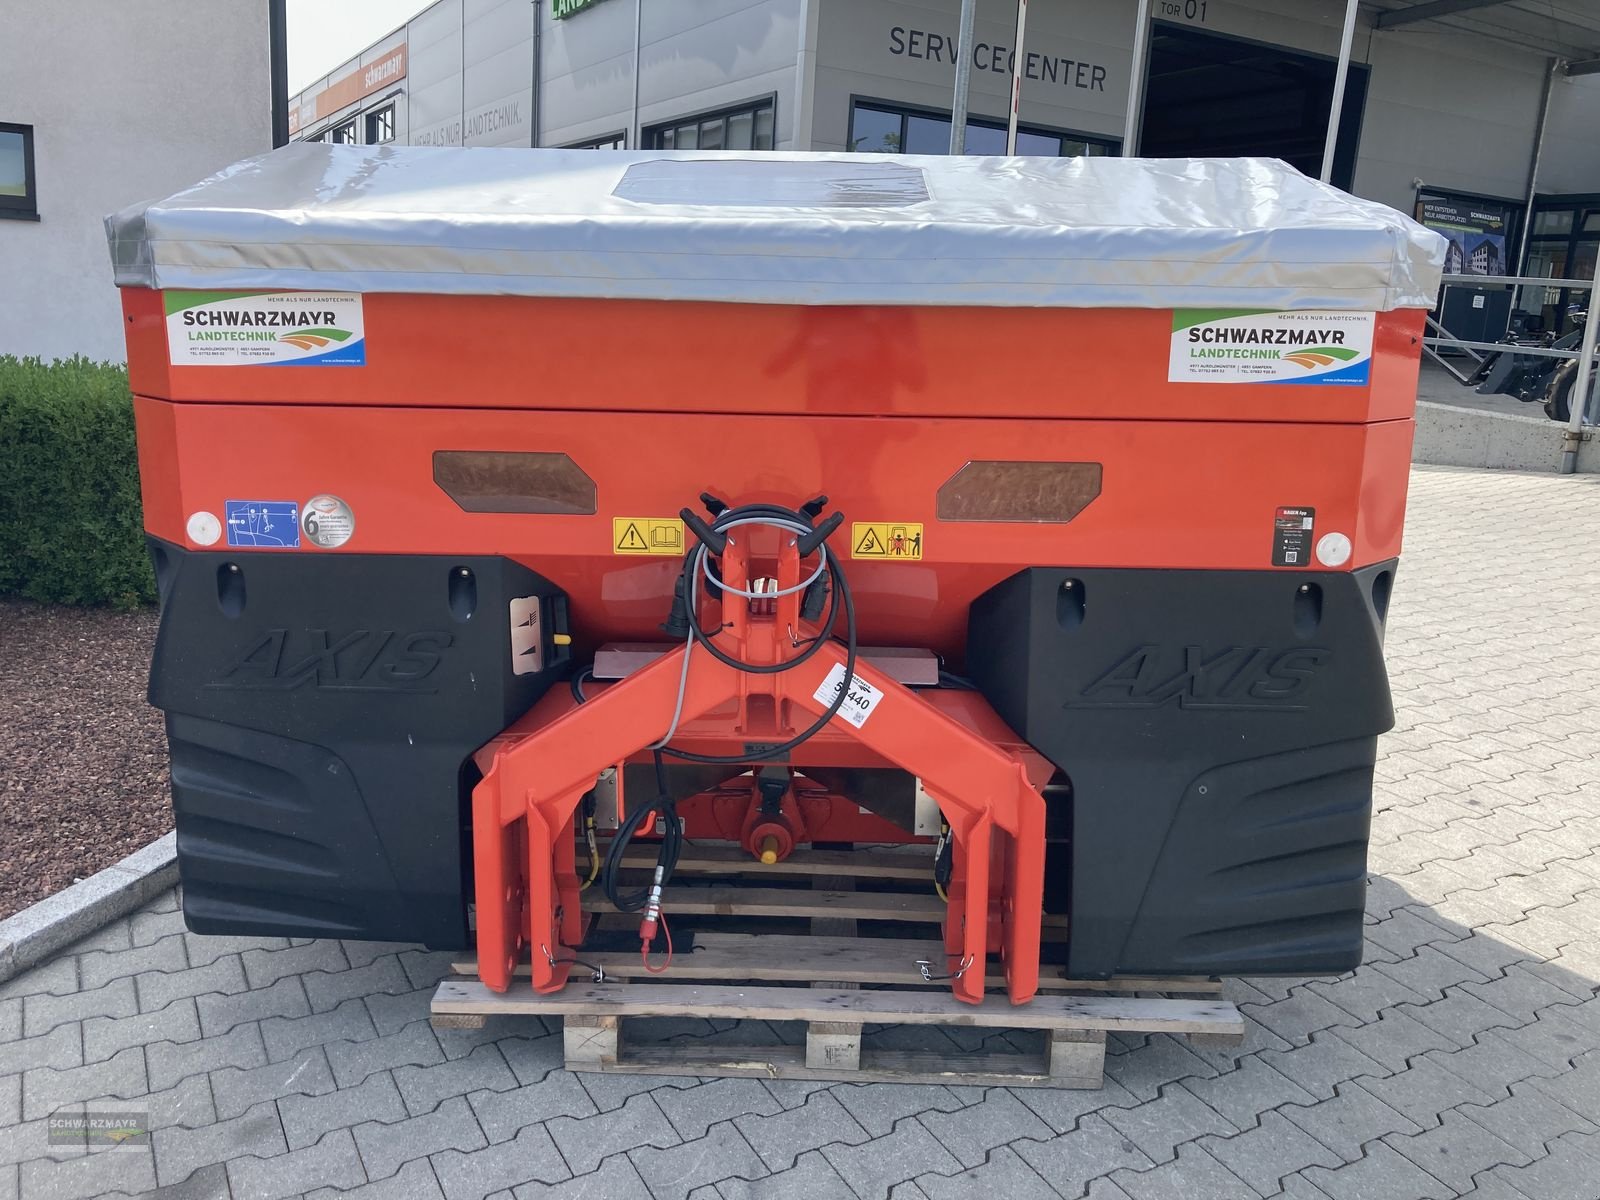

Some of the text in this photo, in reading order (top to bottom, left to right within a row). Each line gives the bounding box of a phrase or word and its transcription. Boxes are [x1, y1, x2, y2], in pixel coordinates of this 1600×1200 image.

[1161, 0, 1207, 22] TOR 01
[889, 26, 1106, 92] SERVCEENTER
[445, 122, 460, 144] NUR
[183, 310, 336, 327] SCHWARZMAYR
[188, 331, 277, 341] LANDTECHNIK
[1188, 327, 1345, 345] SCHWARZMAYR
[1190, 348, 1281, 359] LANDTECHNIK
[303, 511, 319, 536] 6
[222, 629, 455, 683] AXIS
[1077, 644, 1333, 702] AXIS
[834, 681, 870, 710] 5440
